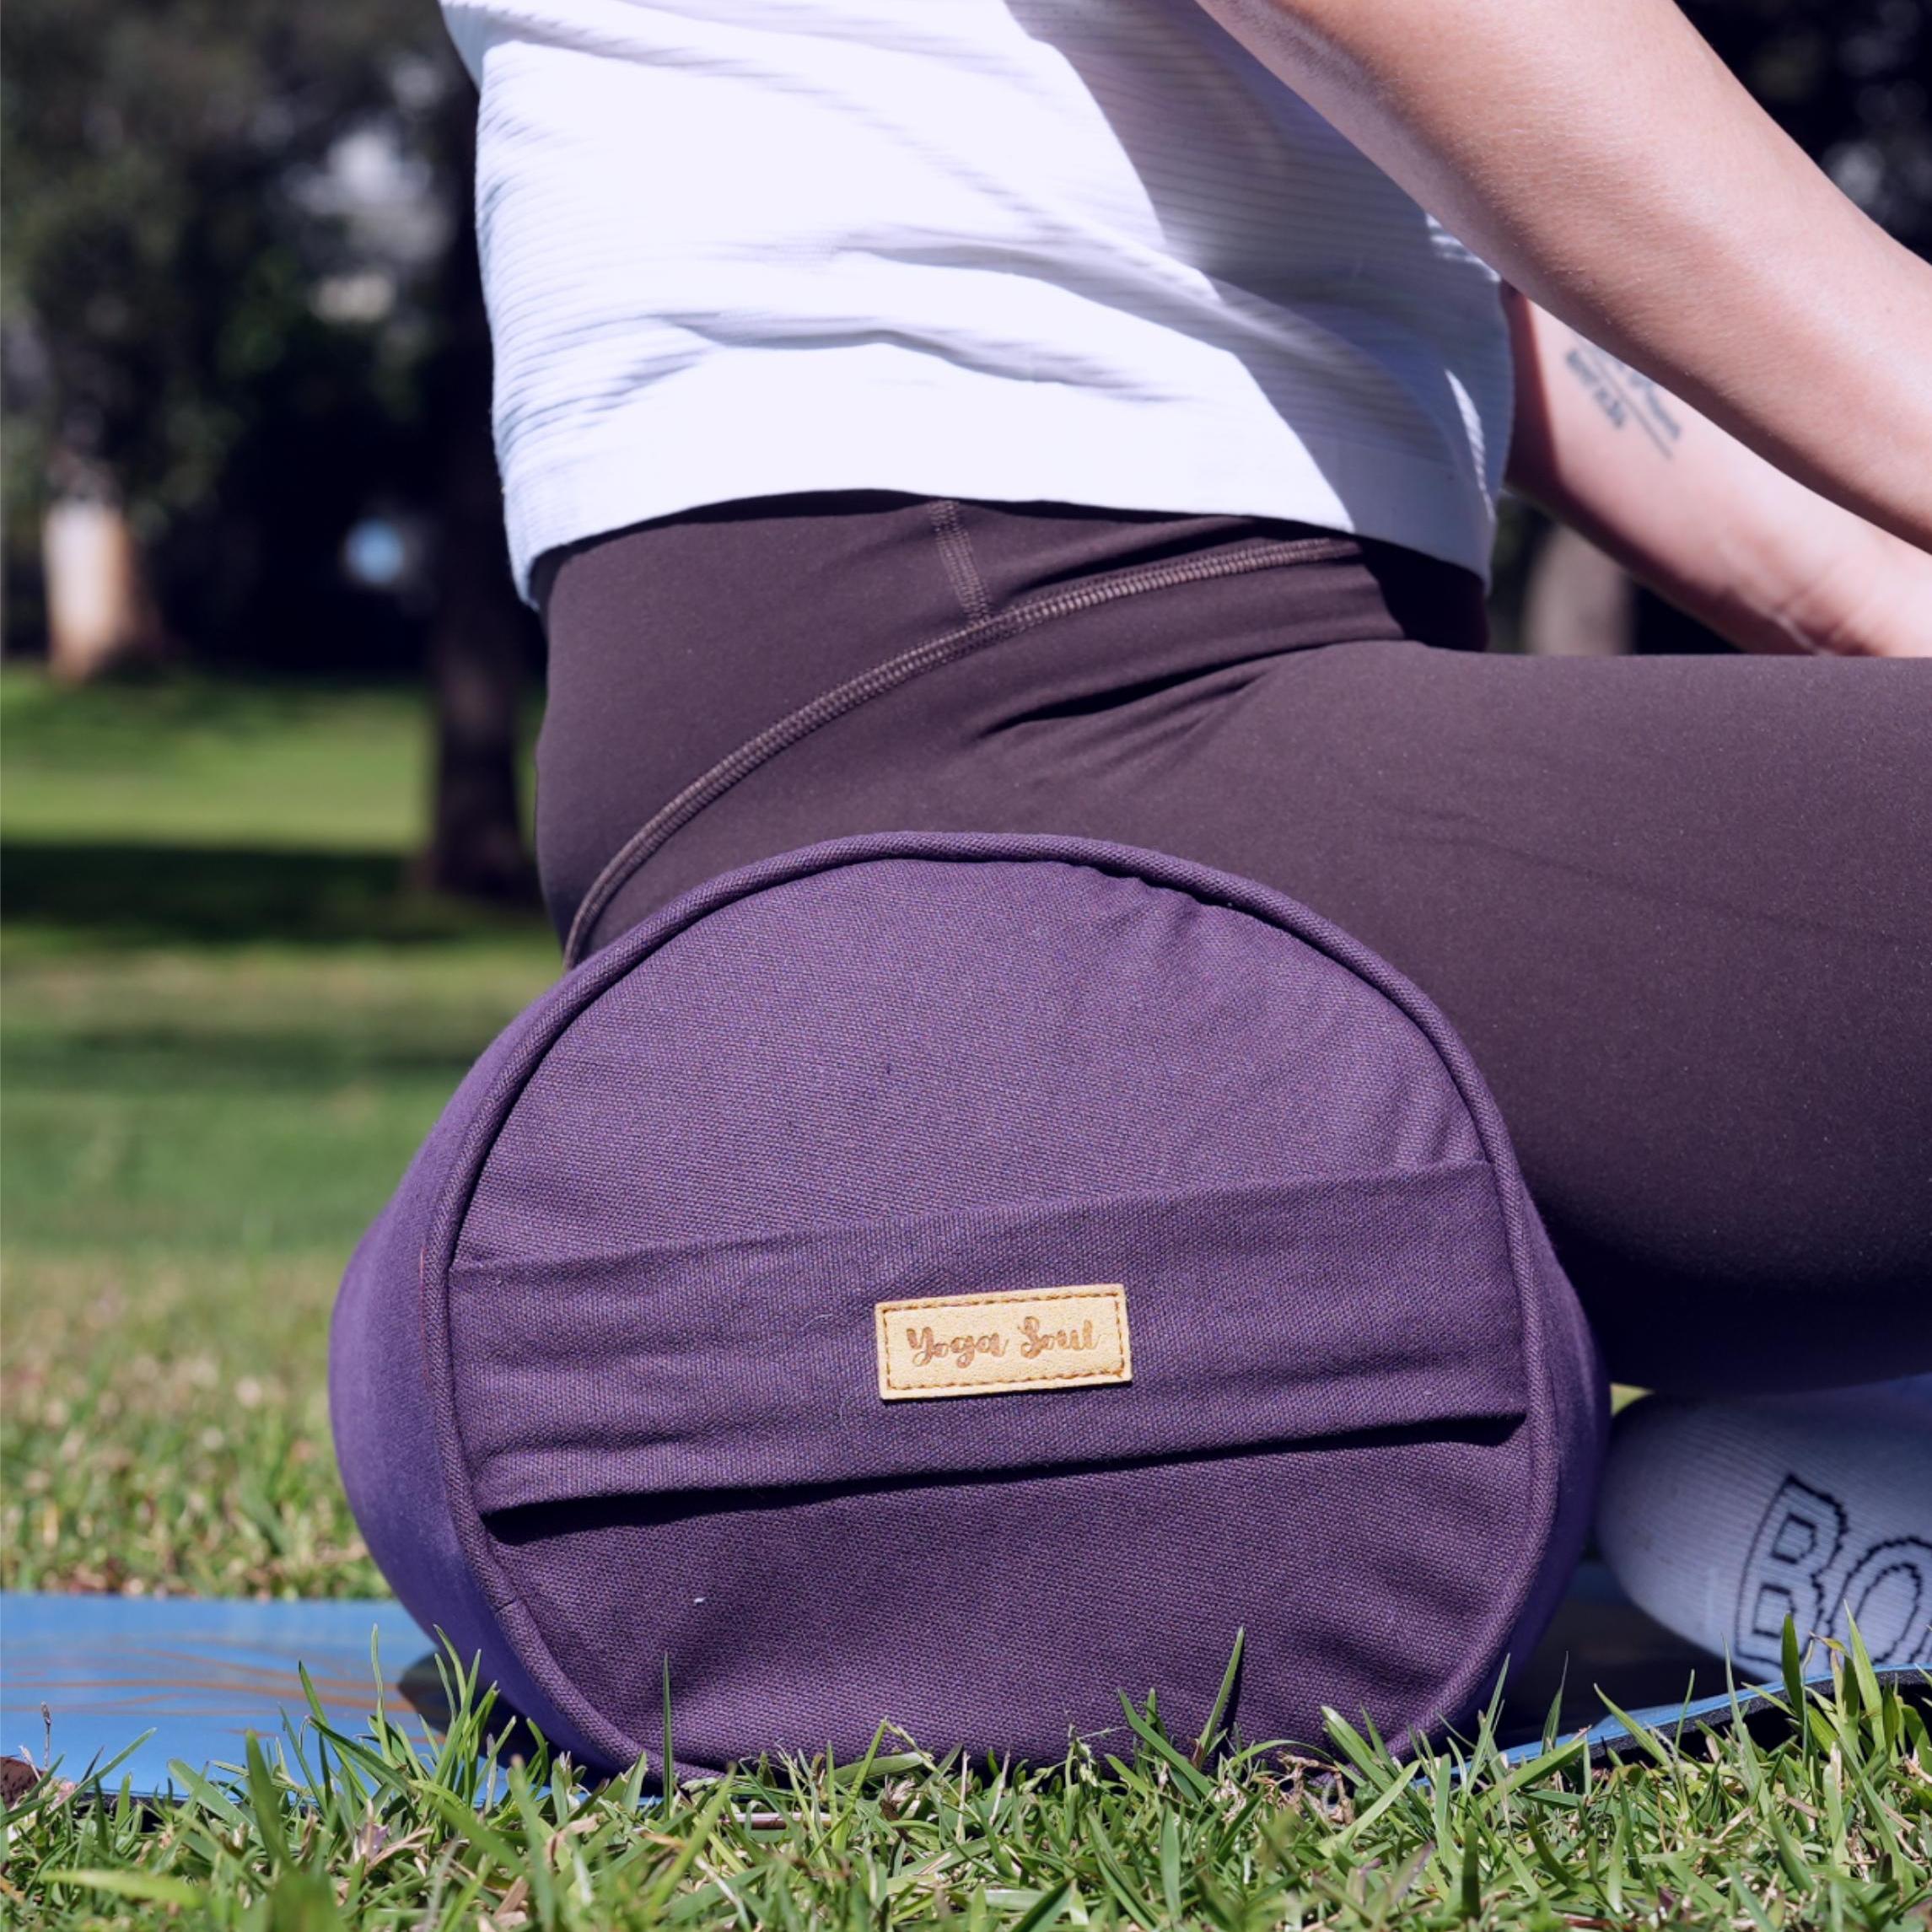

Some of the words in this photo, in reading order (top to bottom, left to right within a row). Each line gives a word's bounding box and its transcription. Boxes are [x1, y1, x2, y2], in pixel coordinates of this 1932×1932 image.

[907, 1327, 1009, 1368] Yoga
[1018, 1316, 1101, 1359] Soul
[1735, 1473, 1932, 1668] BO
